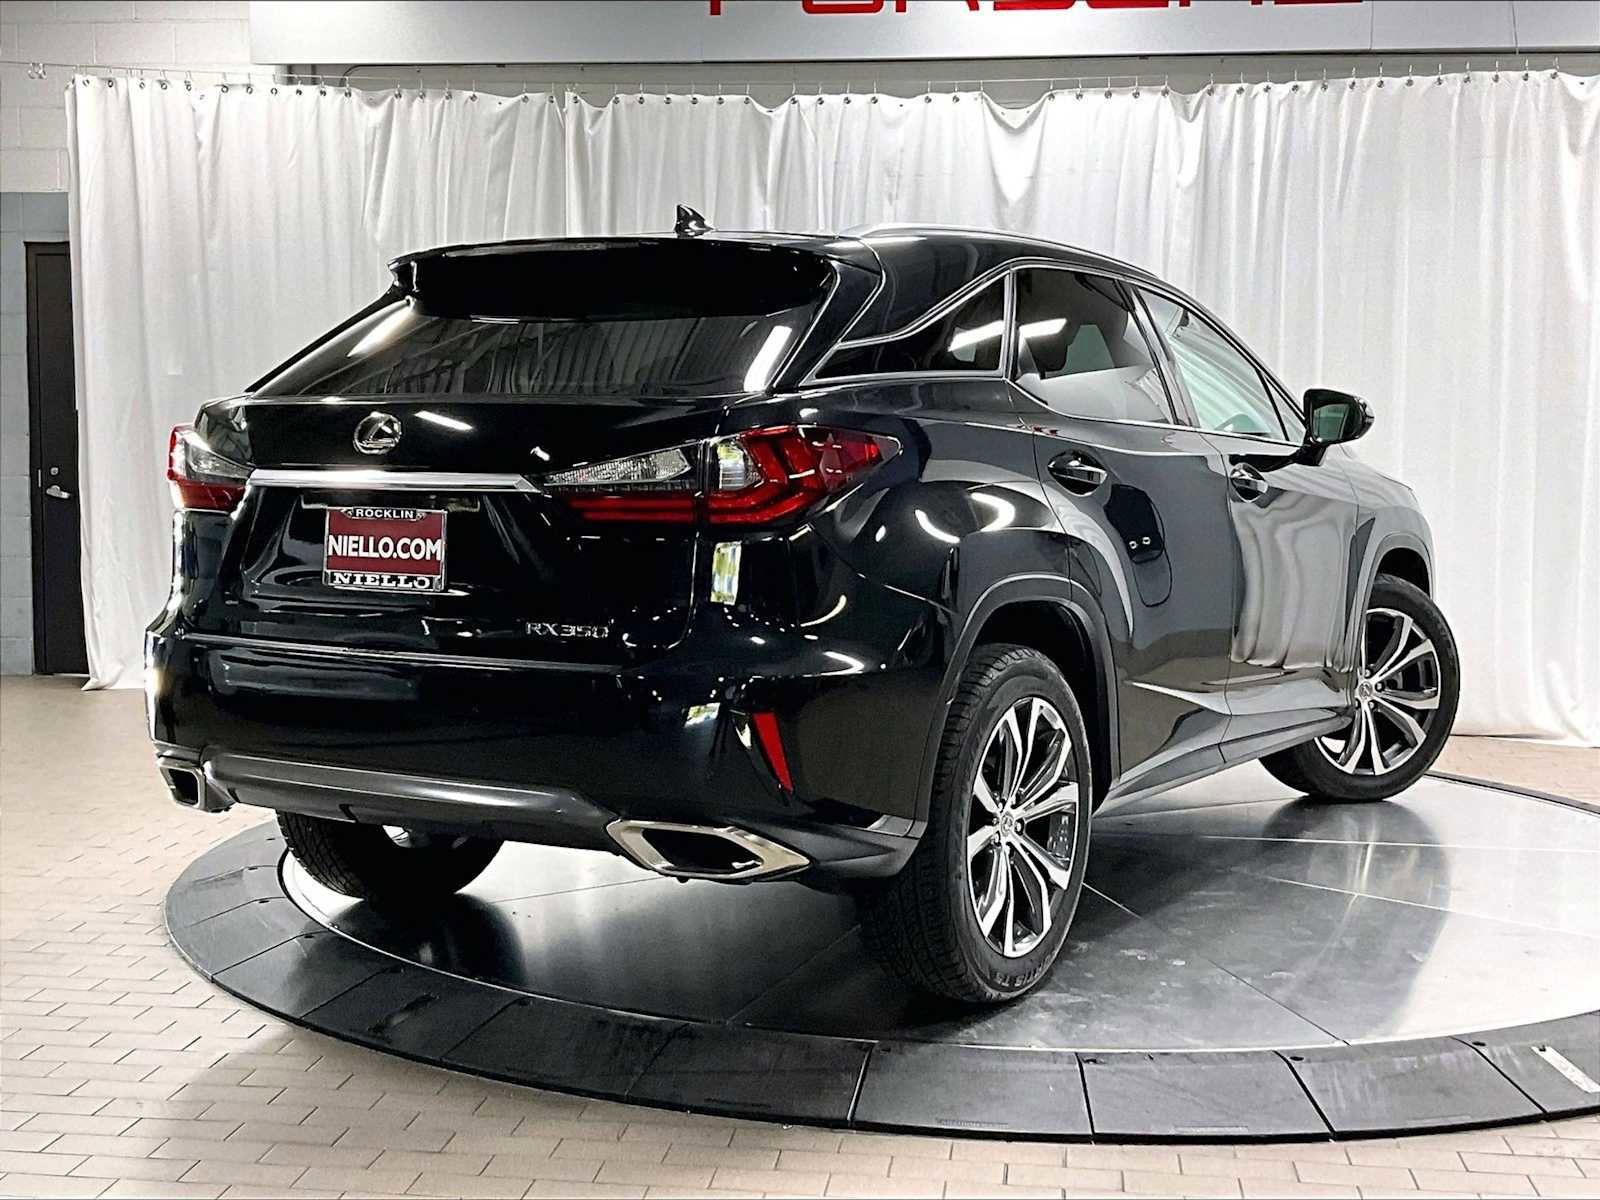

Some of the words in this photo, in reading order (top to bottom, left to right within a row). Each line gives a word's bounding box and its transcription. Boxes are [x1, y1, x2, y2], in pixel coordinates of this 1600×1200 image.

[355, 508, 414, 519] ROCKLIN
[328, 534, 441, 561] NIELLO.COM
[333, 572, 430, 589] NIELLO
